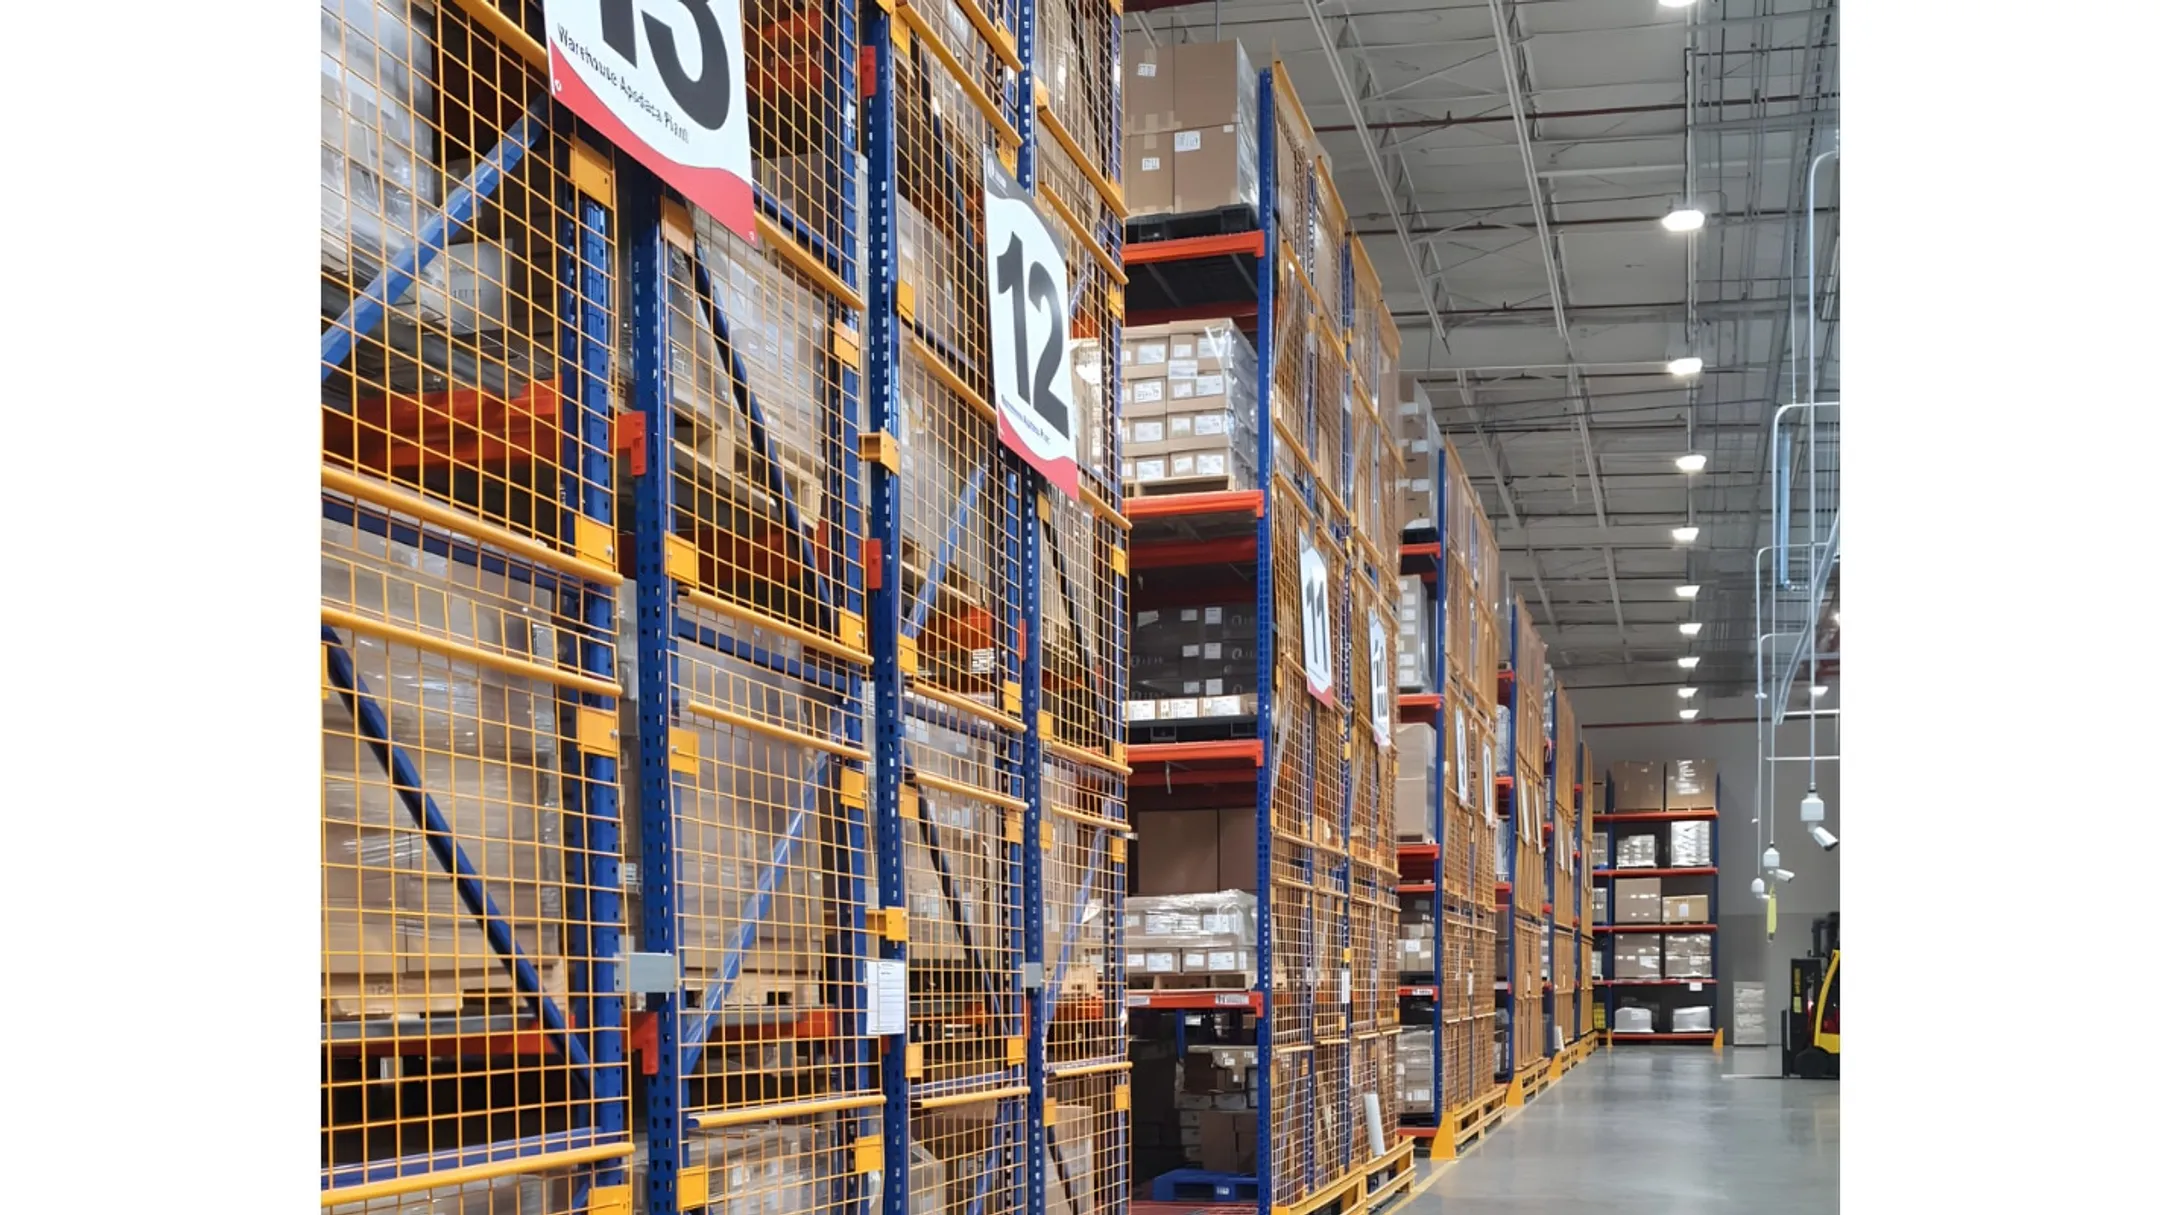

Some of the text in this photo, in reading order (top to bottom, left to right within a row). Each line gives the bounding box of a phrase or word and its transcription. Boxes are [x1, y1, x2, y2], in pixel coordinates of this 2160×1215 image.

[556, 22, 618, 86] Warehouse
[996, 230, 1070, 441] 12
[1305, 569, 1328, 674] 11
